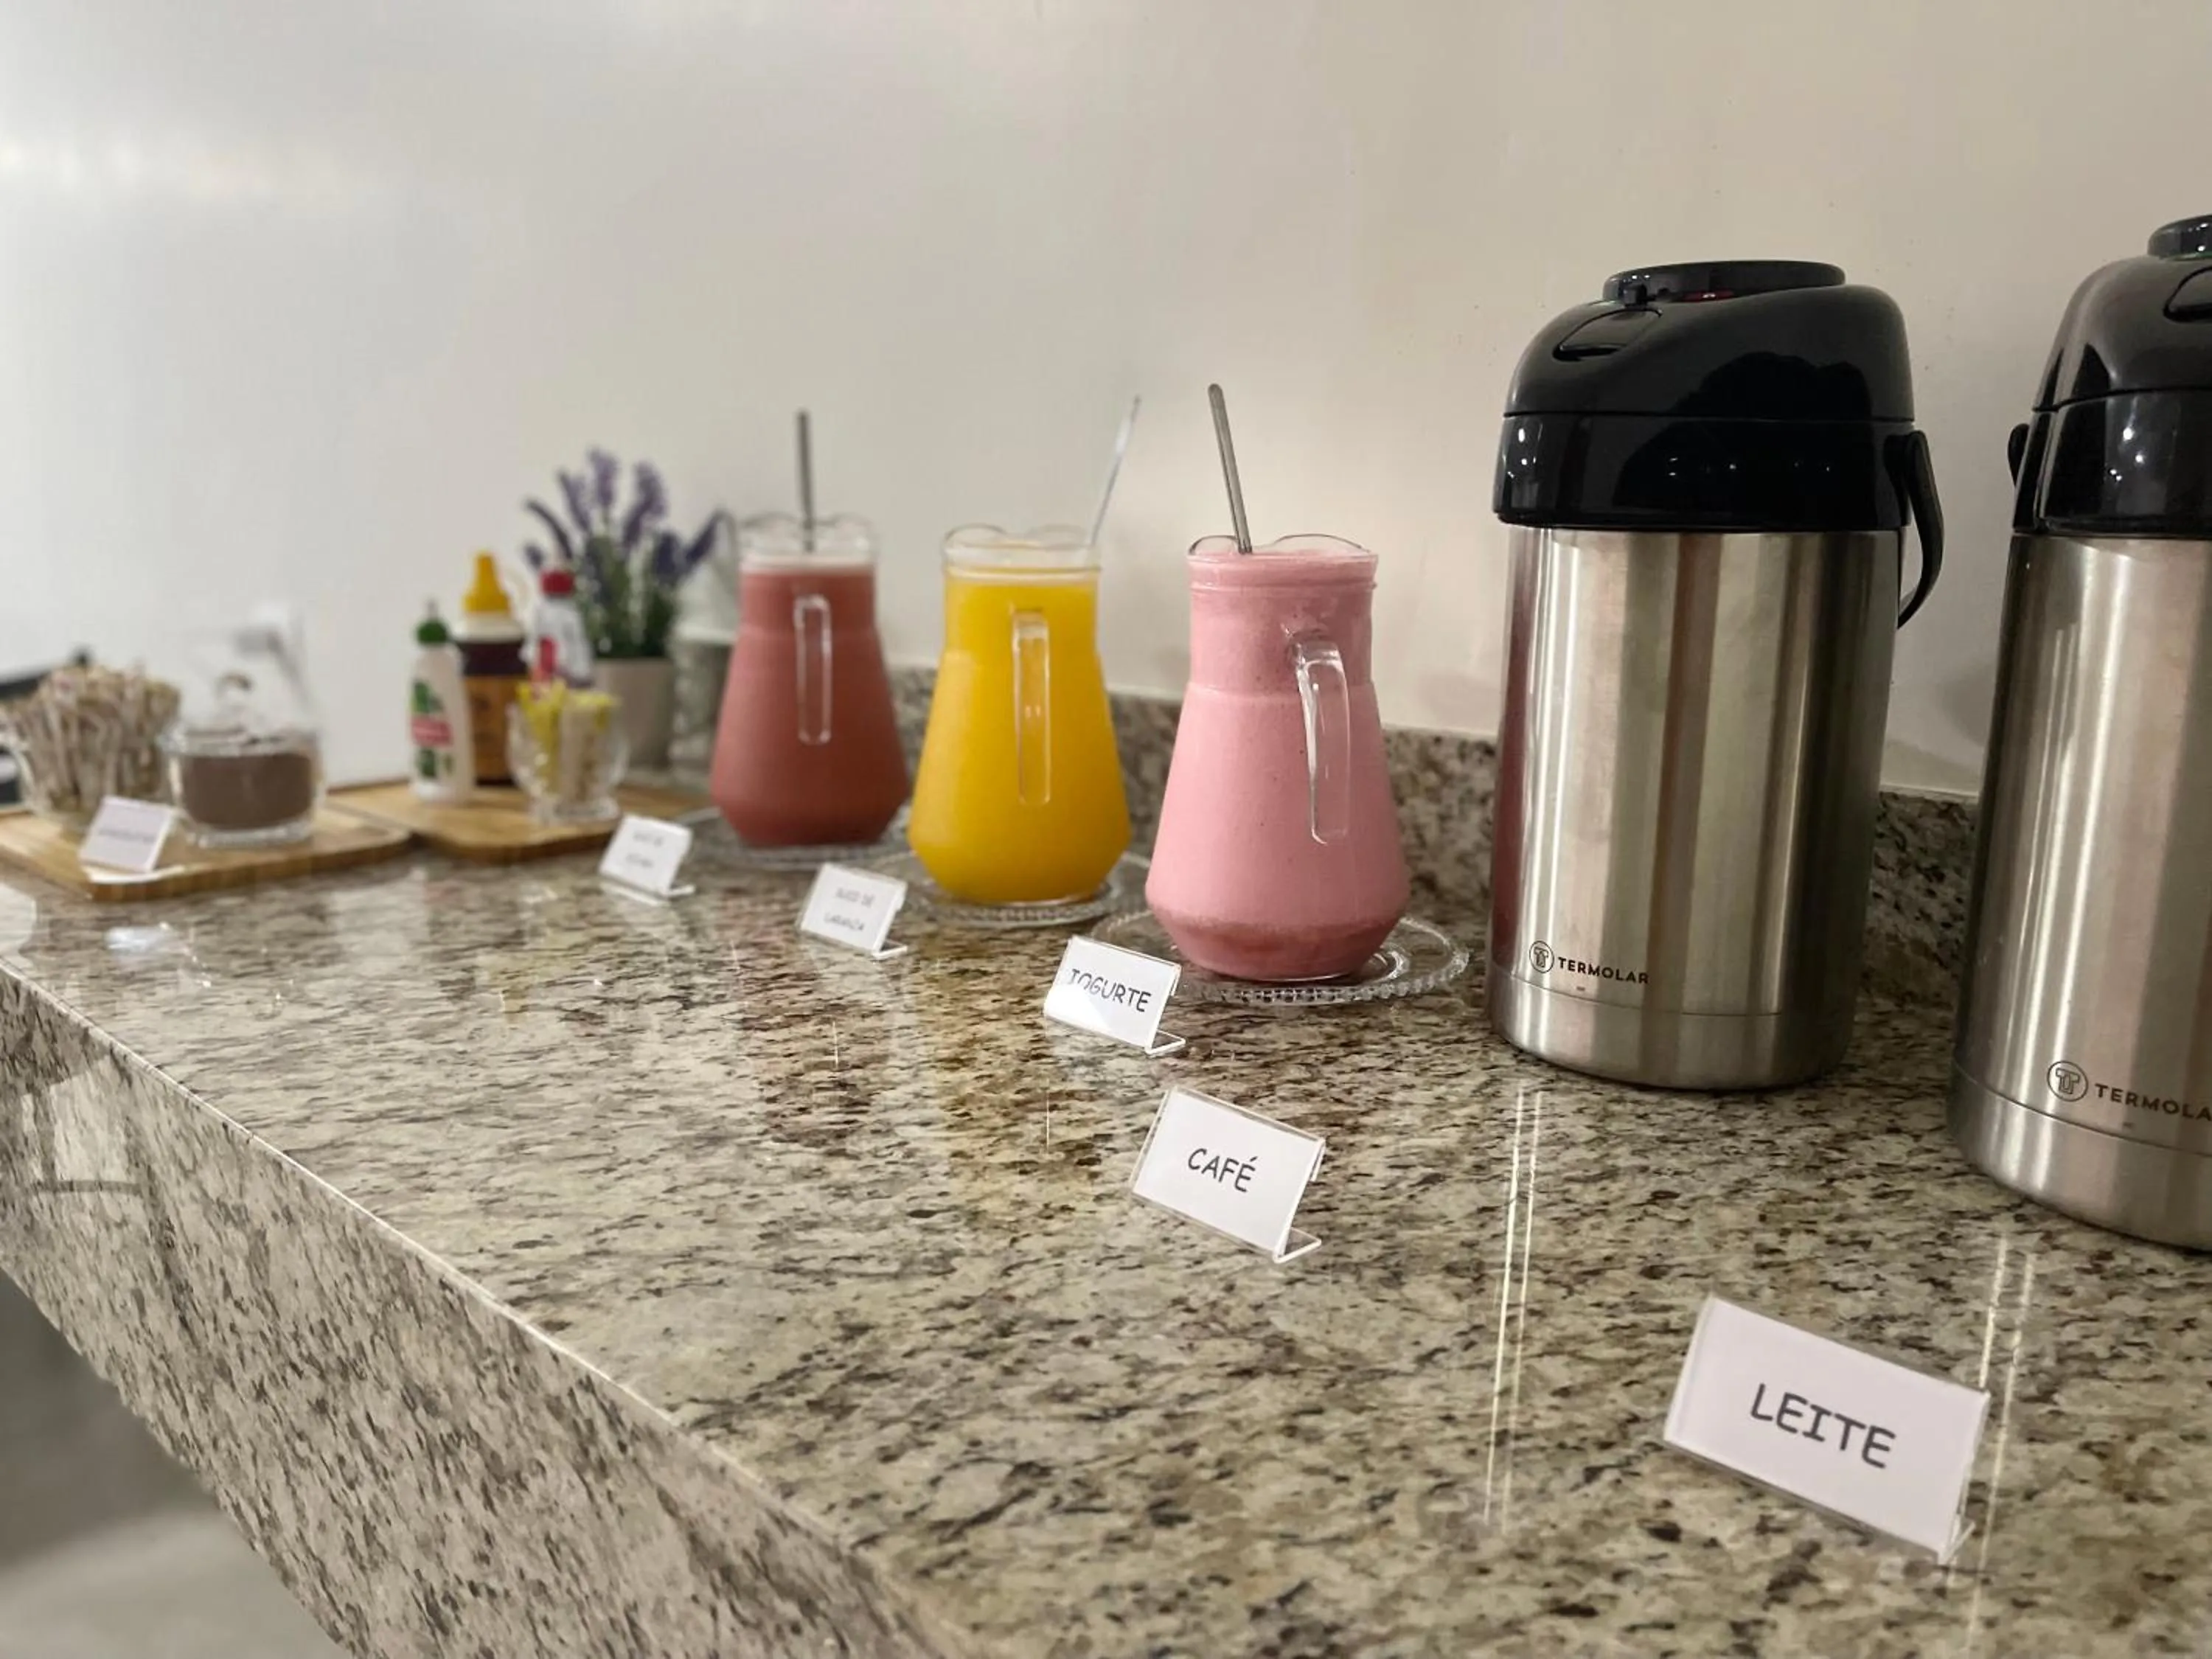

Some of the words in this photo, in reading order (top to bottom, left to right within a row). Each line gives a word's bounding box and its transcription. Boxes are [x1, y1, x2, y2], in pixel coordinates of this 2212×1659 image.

[1068, 968, 1152, 1013] IOGURTE
[1557, 956, 1649, 984] TERMOLAR
[2094, 1082, 2212, 1122] TERMOLA
[1187, 1147, 1259, 1193] CAFÉ
[1750, 1382, 1898, 1470] LEITE
